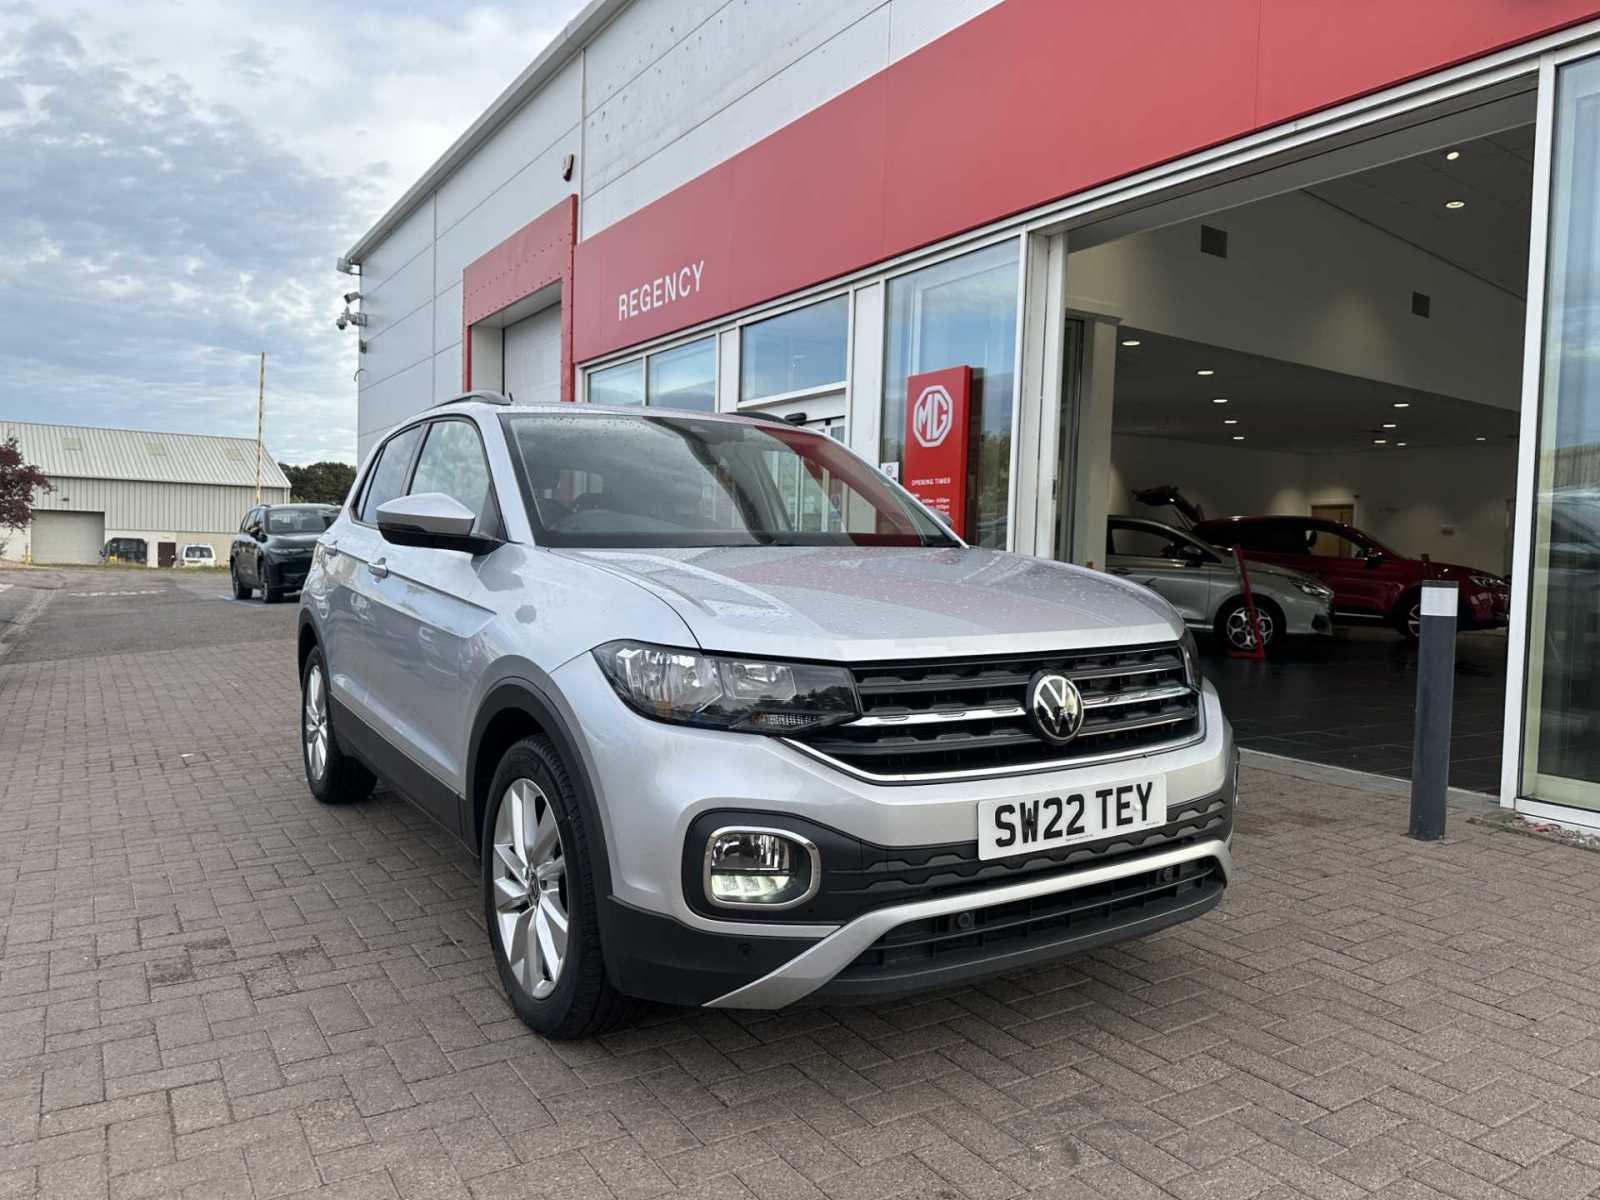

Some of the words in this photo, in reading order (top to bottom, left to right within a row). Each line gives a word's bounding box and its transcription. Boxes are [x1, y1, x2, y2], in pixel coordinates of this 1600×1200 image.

[618, 259, 705, 321] REGENCY
[917, 392, 948, 441] MG
[994, 793, 1086, 848] SW22
[1095, 781, 1153, 830] TEY
